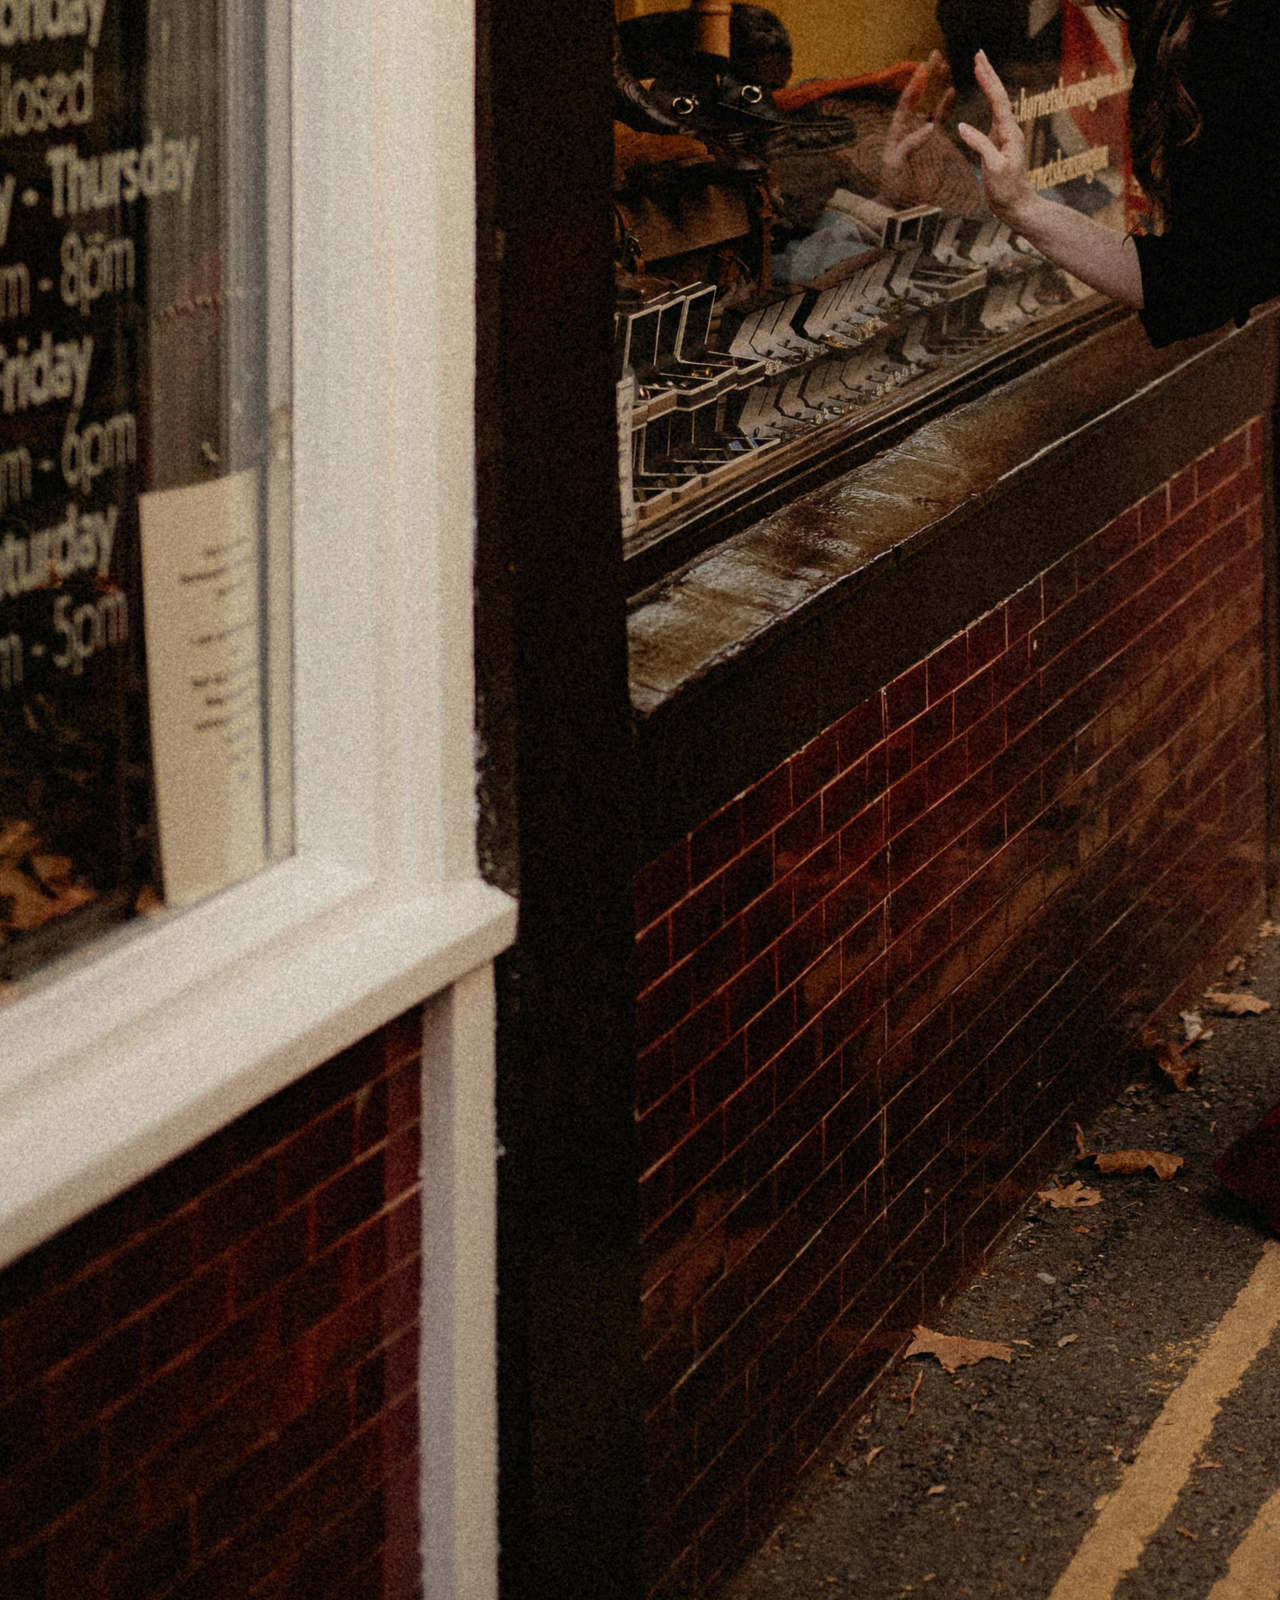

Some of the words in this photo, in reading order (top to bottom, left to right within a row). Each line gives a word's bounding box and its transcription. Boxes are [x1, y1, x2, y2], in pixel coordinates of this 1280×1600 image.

[46, 126, 200, 219] Thursday
[59, 231, 136, 317] 8pm
[0, 330, 95, 416] riday
[61, 410, 138, 497] 6pm
[52, 588, 129, 677] 5pm
